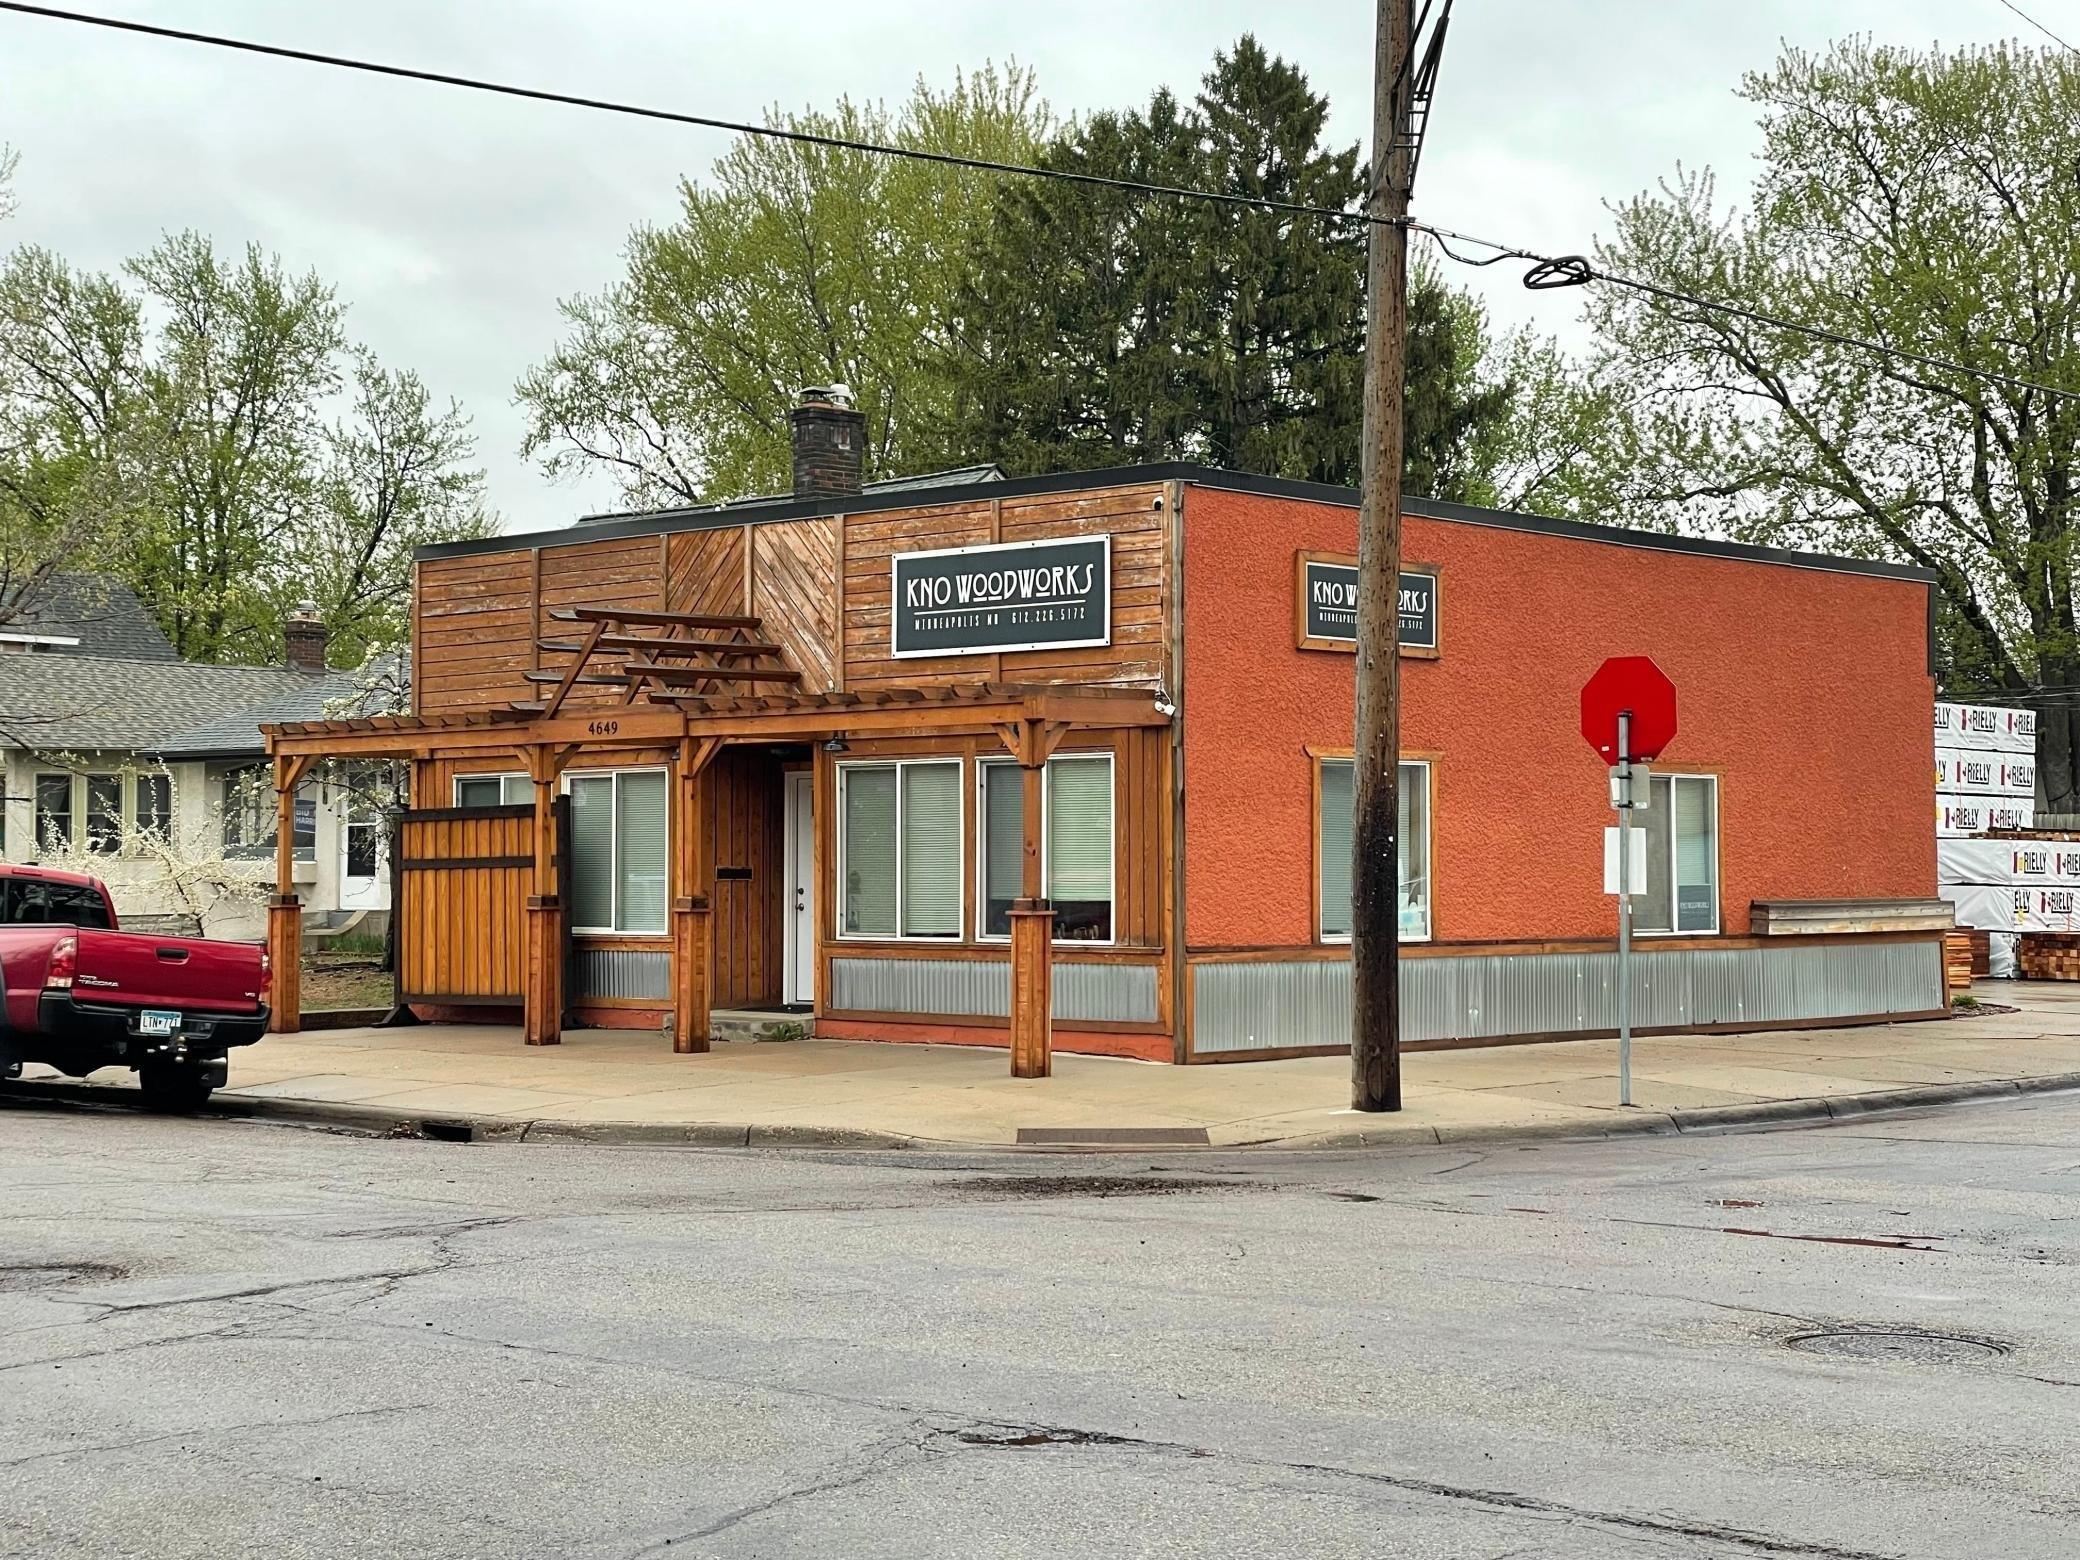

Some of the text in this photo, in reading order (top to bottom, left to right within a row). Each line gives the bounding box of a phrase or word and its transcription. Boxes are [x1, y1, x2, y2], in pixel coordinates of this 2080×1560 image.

[907, 563, 1094, 608] KNO WOODWORKS
[1313, 580, 1343, 606] KNO
[914, 614, 979, 631] MINNEAPOLIS
[1012, 607, 1085, 624] 612.226.5172
[1935, 707, 1951, 727] ELLY
[1972, 710, 1997, 731] RIELLY
[2018, 714, 2035, 733] RIEL
[588, 721, 618, 735] 4649
[1967, 763, 1991, 783] RIELLY
[2012, 766, 2034, 785] RIELLY
[1955, 808, 1979, 828] RIELLY
[2000, 810, 2023, 828] RIELLY
[2024, 852, 2047, 872] RIELLY
[2014, 891, 2030, 911] ELLY
[2051, 891, 2074, 912] RIELLY
